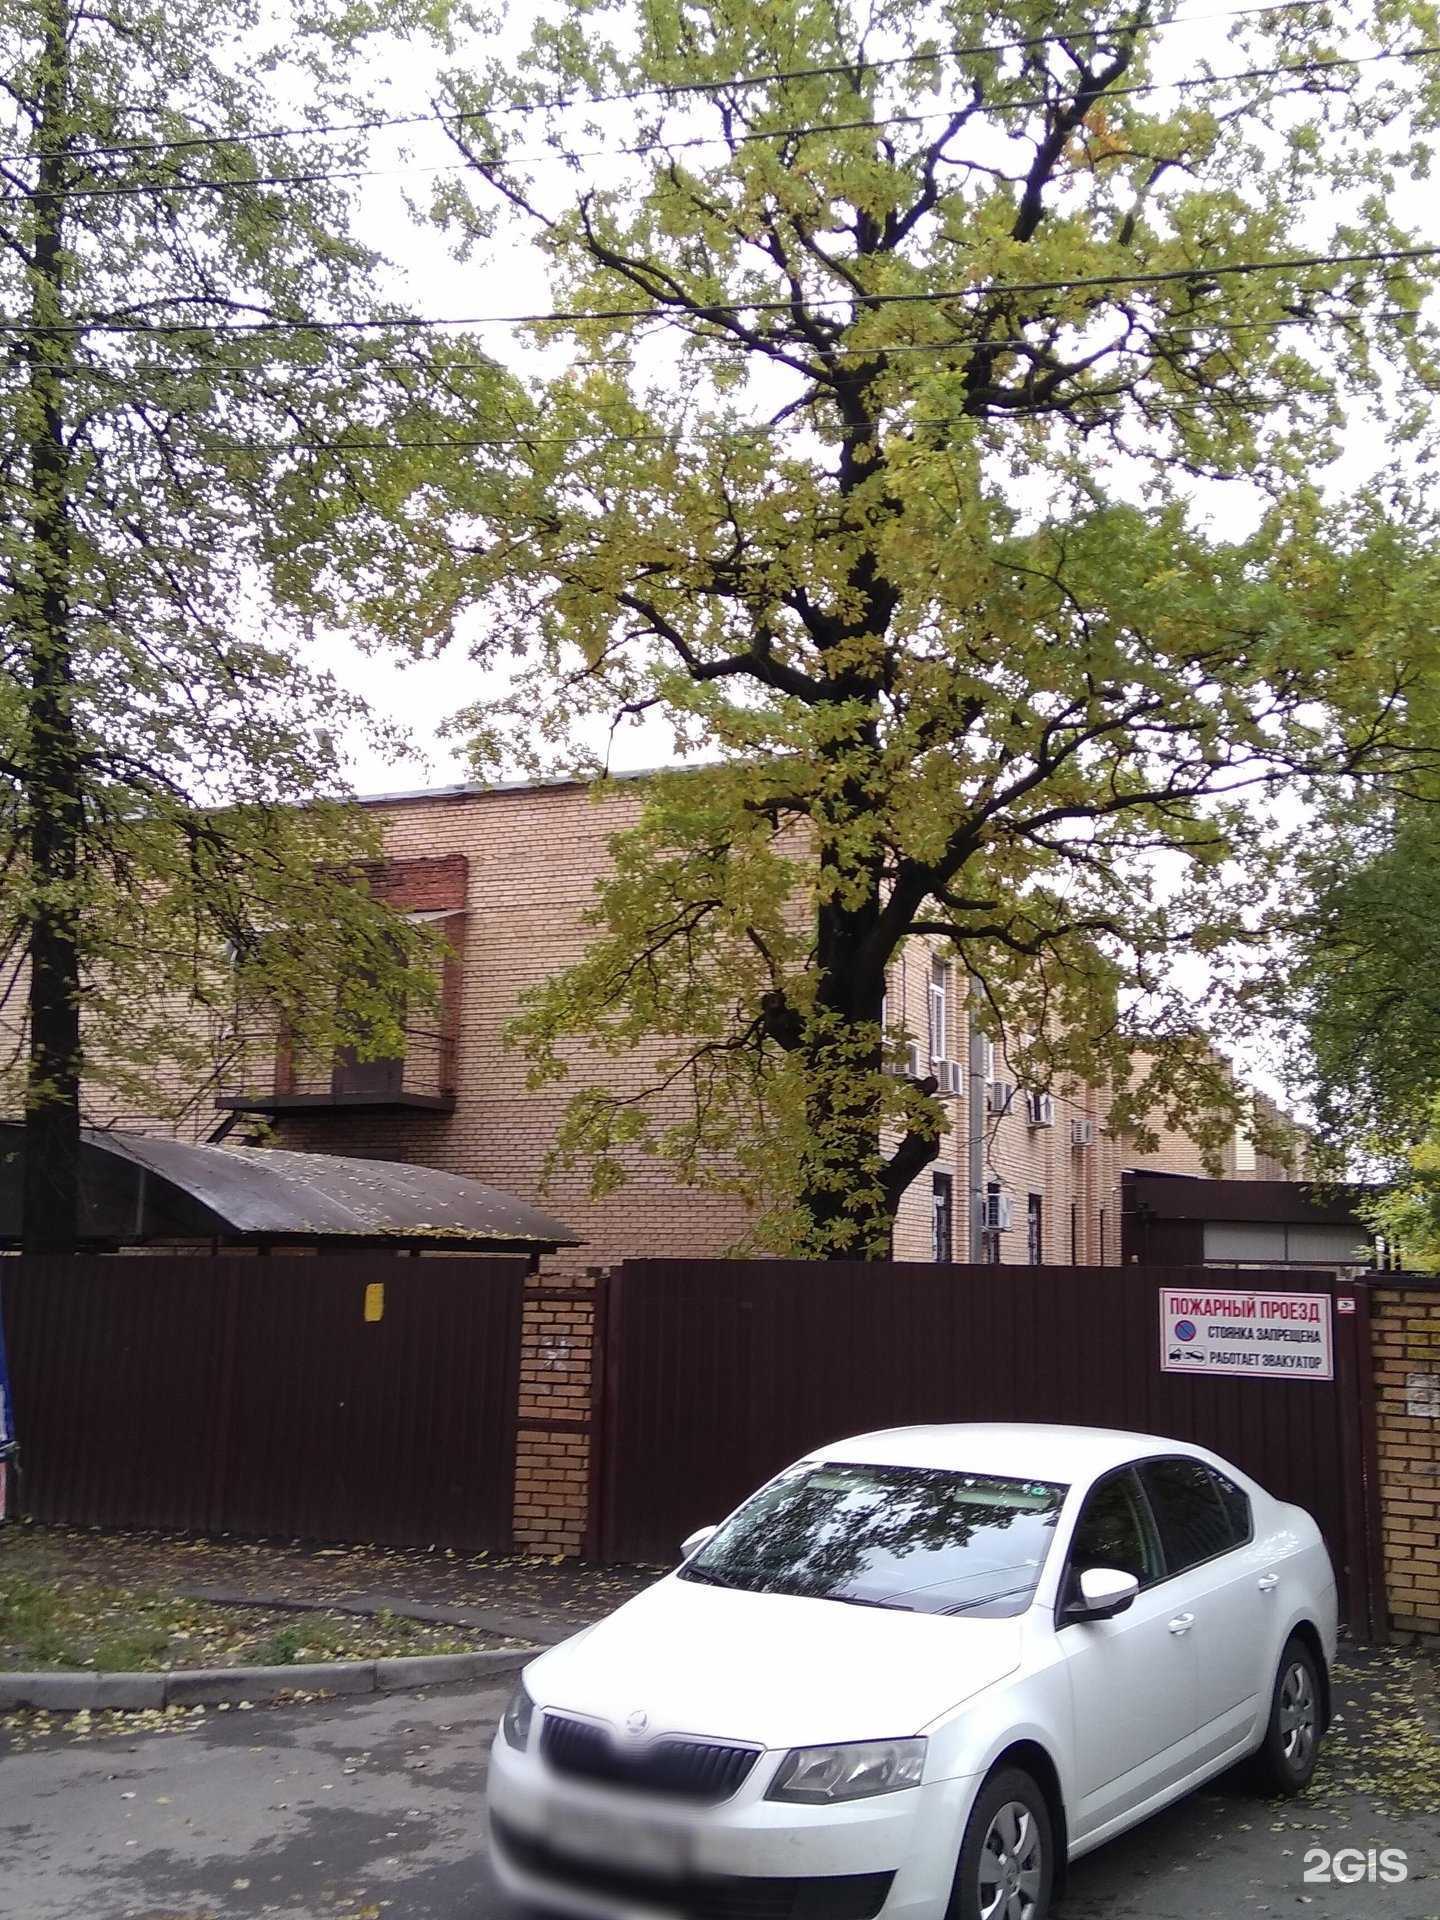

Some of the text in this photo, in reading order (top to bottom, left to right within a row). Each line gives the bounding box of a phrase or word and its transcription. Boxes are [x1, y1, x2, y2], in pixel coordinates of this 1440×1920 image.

[1170, 1297, 1320, 1323] ПОЖАРНЫЙ ПРОЕЗД
[1208, 1326, 1321, 1343] СТОЯНКА ЗАПРЕЩЕНА
[1209, 1351, 1322, 1369] РАБОТАЕТ ЭВАКУАТОР
